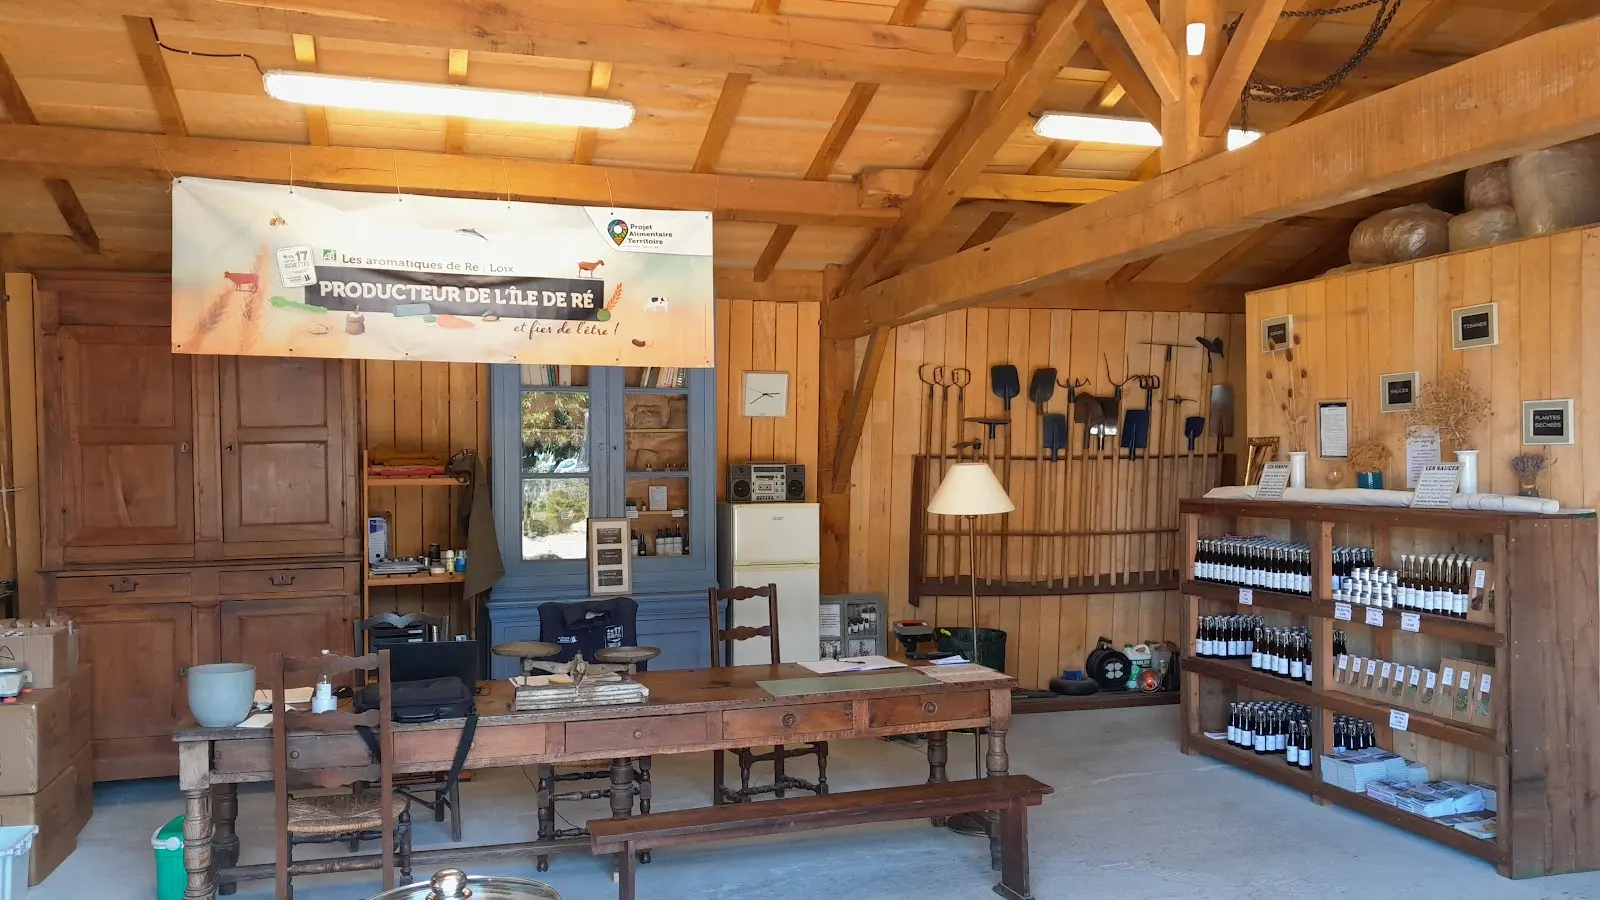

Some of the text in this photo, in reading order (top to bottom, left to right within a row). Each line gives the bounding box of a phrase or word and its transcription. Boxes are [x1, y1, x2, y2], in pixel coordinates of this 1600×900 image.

[295, 250, 308, 261] 17
[341, 254, 362, 265] Les
[365, 257, 442, 271] aromatiques
[444, 261, 460, 271] de
[489, 263, 514, 273] Loix
[319, 281, 595, 309] PRODUCTEUR DE L'ÎLE DE RÉ
[513, 322, 526, 333] et
[528, 320, 552, 340] fier
[557, 321, 572, 334] de
[576, 321, 609, 336] l'être
[1463, 320, 1488, 329] TISANES
